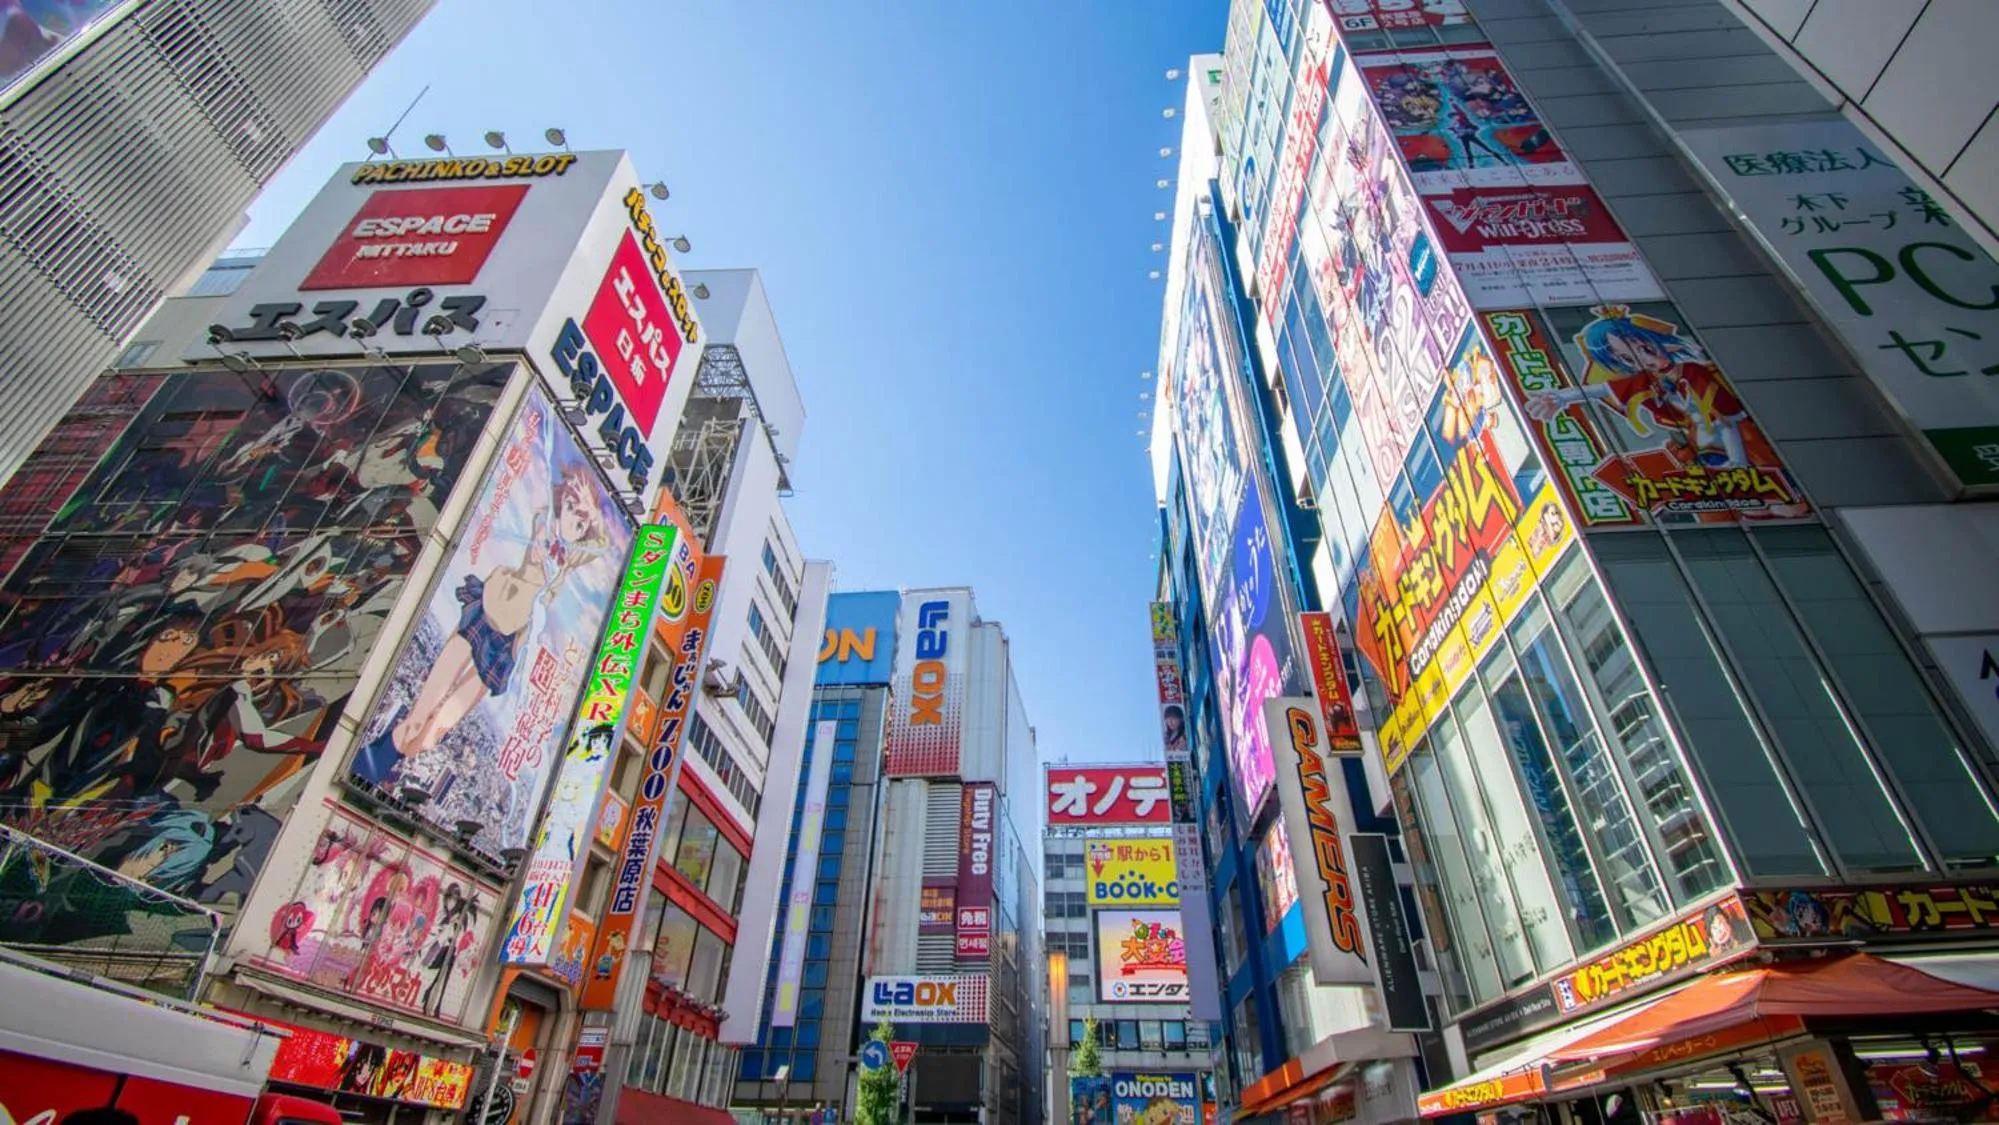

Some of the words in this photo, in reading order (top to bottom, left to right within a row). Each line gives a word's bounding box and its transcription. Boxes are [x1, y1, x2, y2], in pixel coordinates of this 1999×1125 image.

[1722, 147, 1899, 177] 医療法人
[1780, 210, 1896, 236] グループ
[1787, 192, 1850, 212] 木下
[352, 213, 496, 239] ESPACE
[356, 241, 458, 259] NITTAKU
[226, 286, 487, 342] エスパス
[613, 266, 672, 382] エスパス
[550, 316, 653, 488] ESPACE
[1628, 469, 1797, 509] カードキングダム
[1374, 447, 1517, 697] カードキングダム
[972, 788, 992, 830] Duty
[971, 832, 991, 876] Free
[1287, 707, 1369, 969] GAMERS
[611, 807, 657, 915] 秋葉原店
[1589, 922, 1708, 996] カードキングダム
[1115, 1080, 1194, 1098] ONODEN
